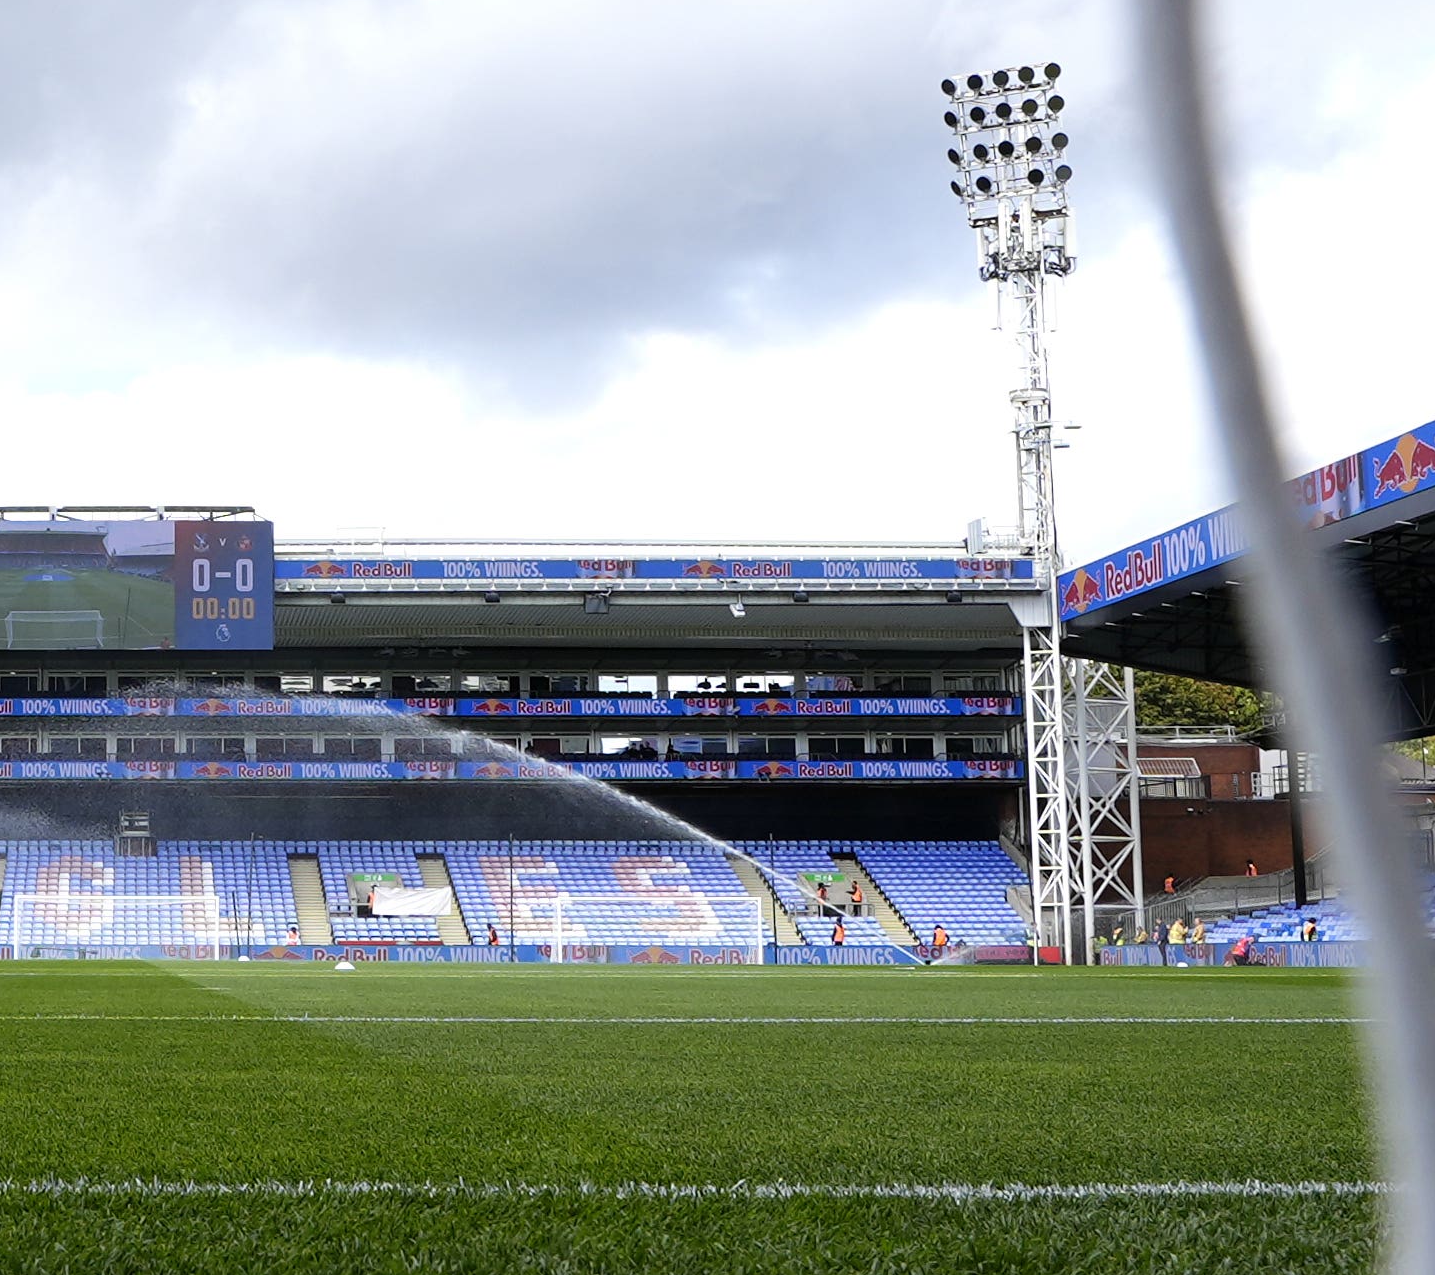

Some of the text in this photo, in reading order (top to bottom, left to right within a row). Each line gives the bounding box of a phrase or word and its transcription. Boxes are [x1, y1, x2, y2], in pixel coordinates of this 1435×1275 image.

[1164, 523, 1206, 577] 100%
[443, 562, 481, 577] 100%
[821, 562, 860, 577] 100%
[192, 597, 255, 620] 00:00
[21, 700, 55, 714] 100%
[580, 700, 615, 714] 100%
[859, 700, 894, 714] 100%
[301, 764, 335, 778] 100%
[861, 763, 896, 777] 100%
